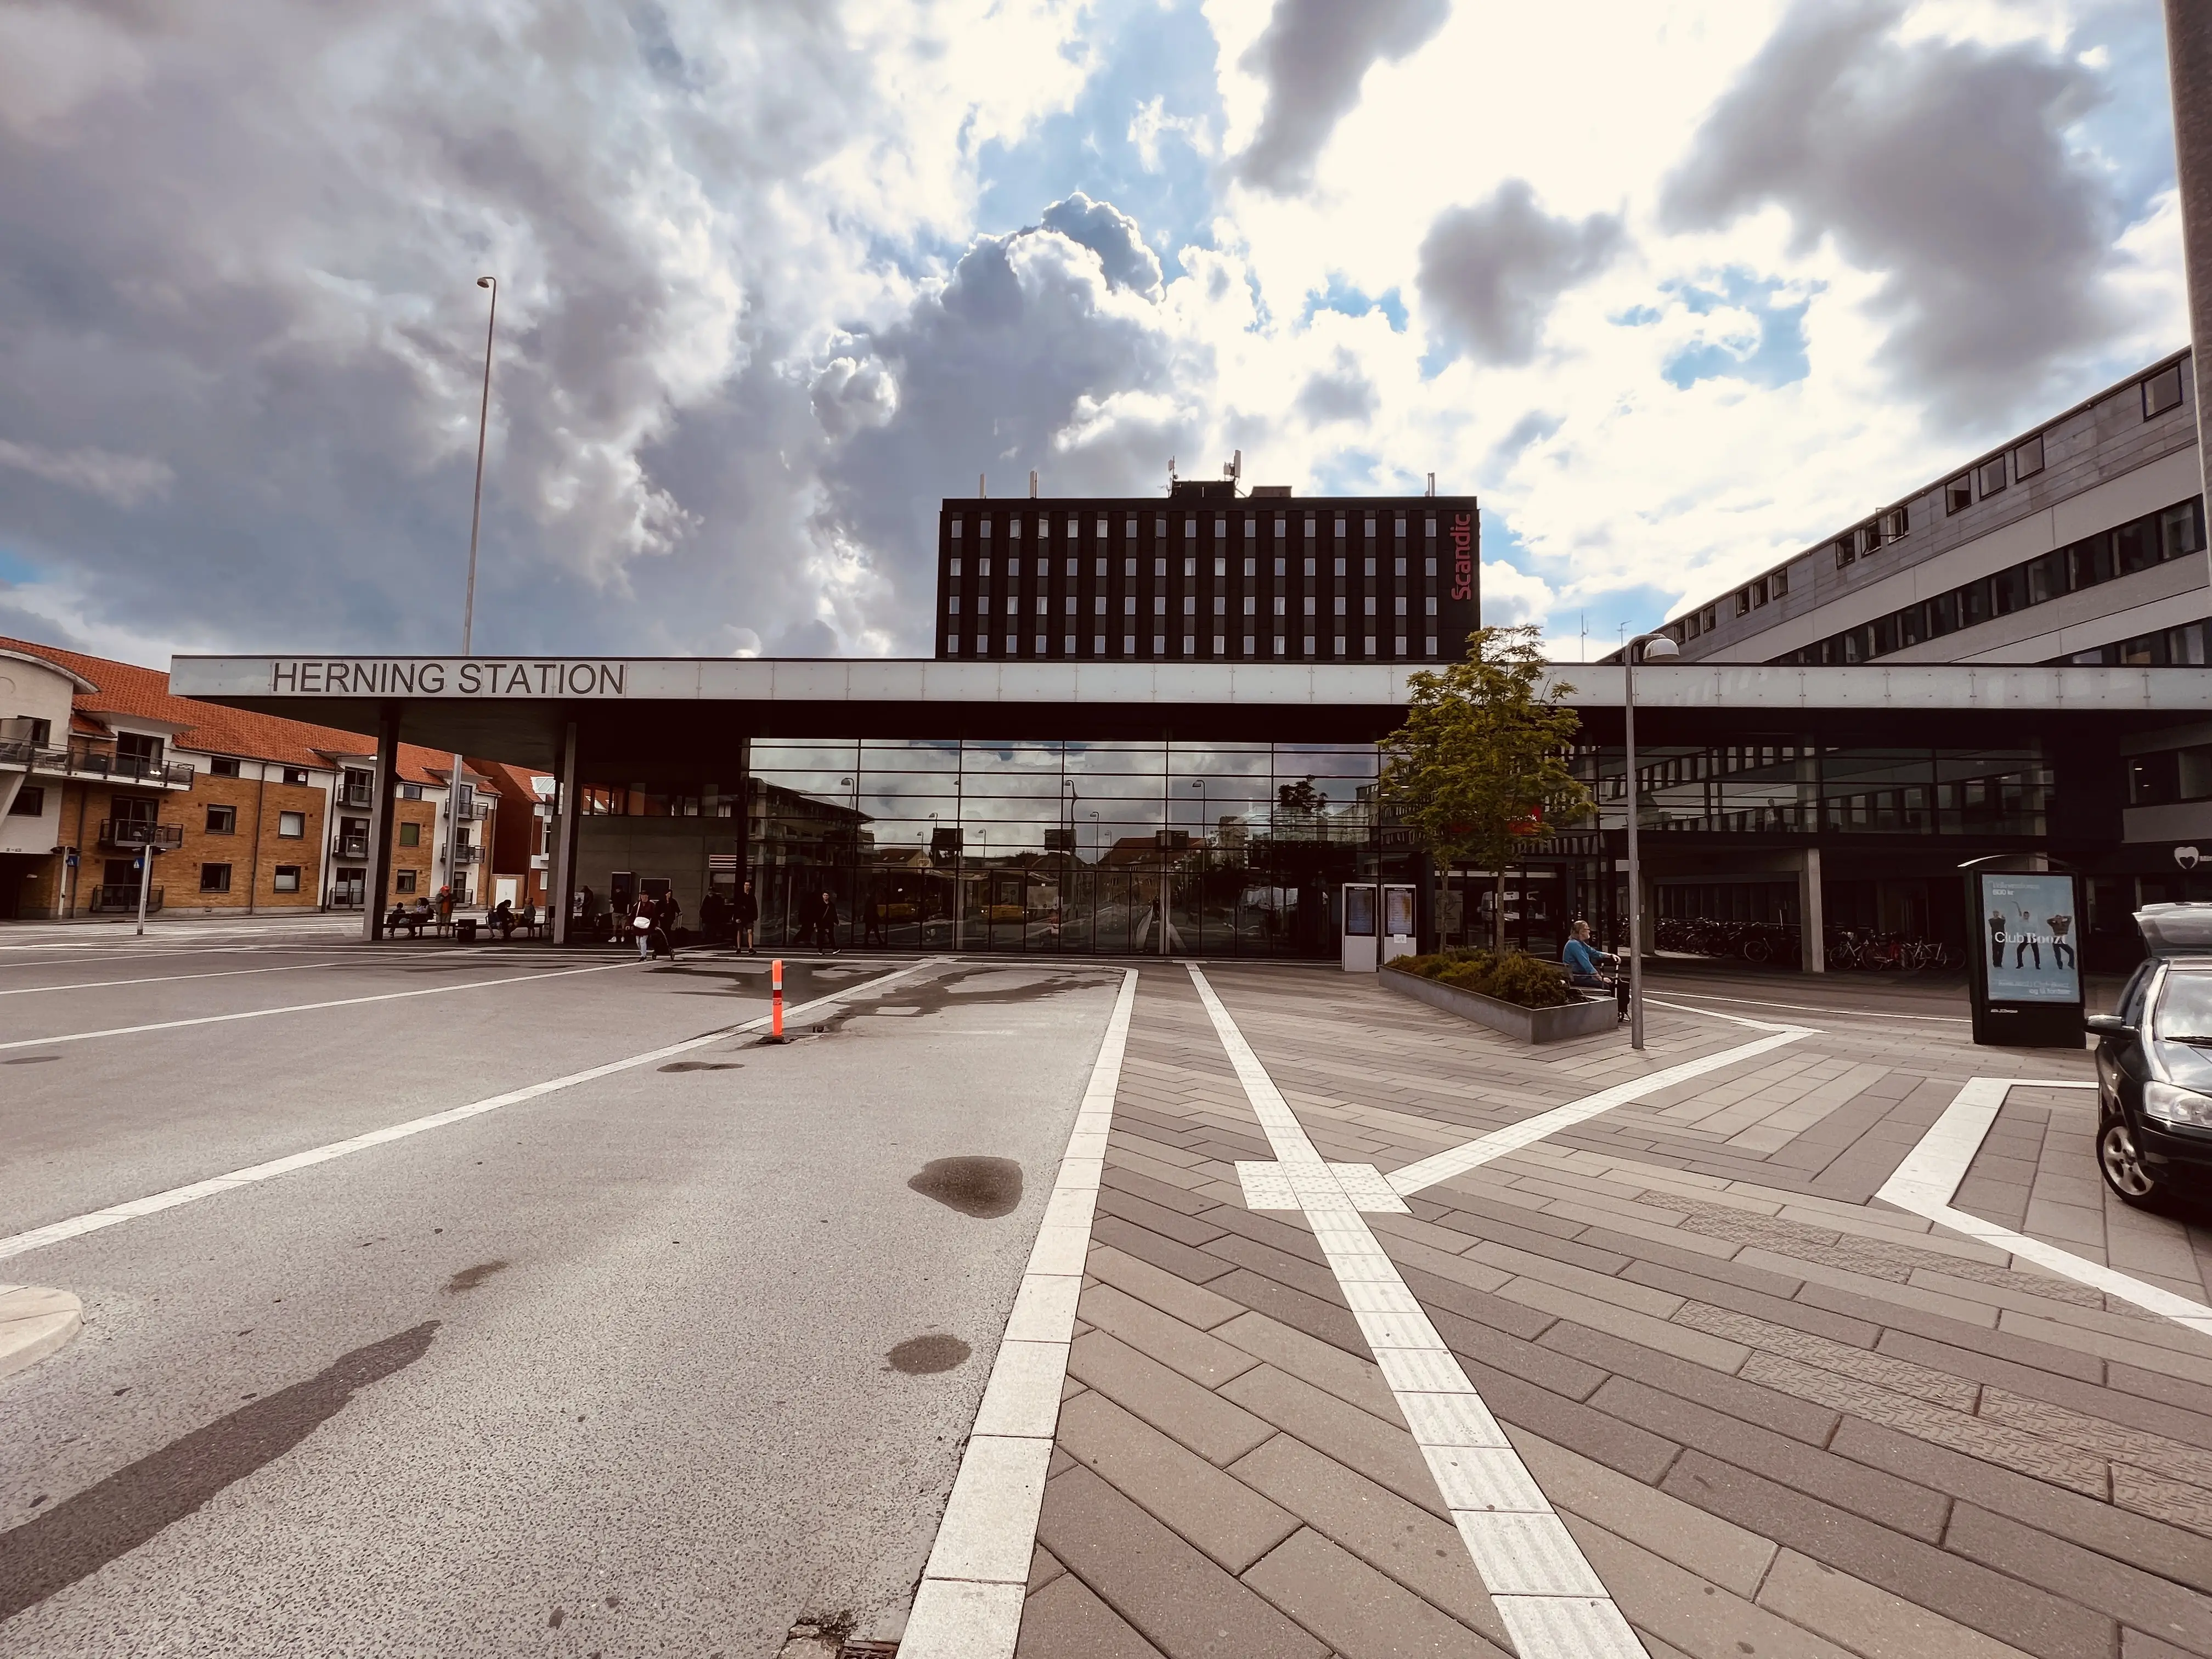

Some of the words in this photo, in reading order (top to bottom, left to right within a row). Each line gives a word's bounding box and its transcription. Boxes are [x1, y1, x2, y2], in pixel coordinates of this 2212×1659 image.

[1450, 514, 1471, 600] Scandic
[273, 663, 444, 693] HERNING
[458, 663, 624, 694] STATION
[1994, 932, 2024, 943] Club
